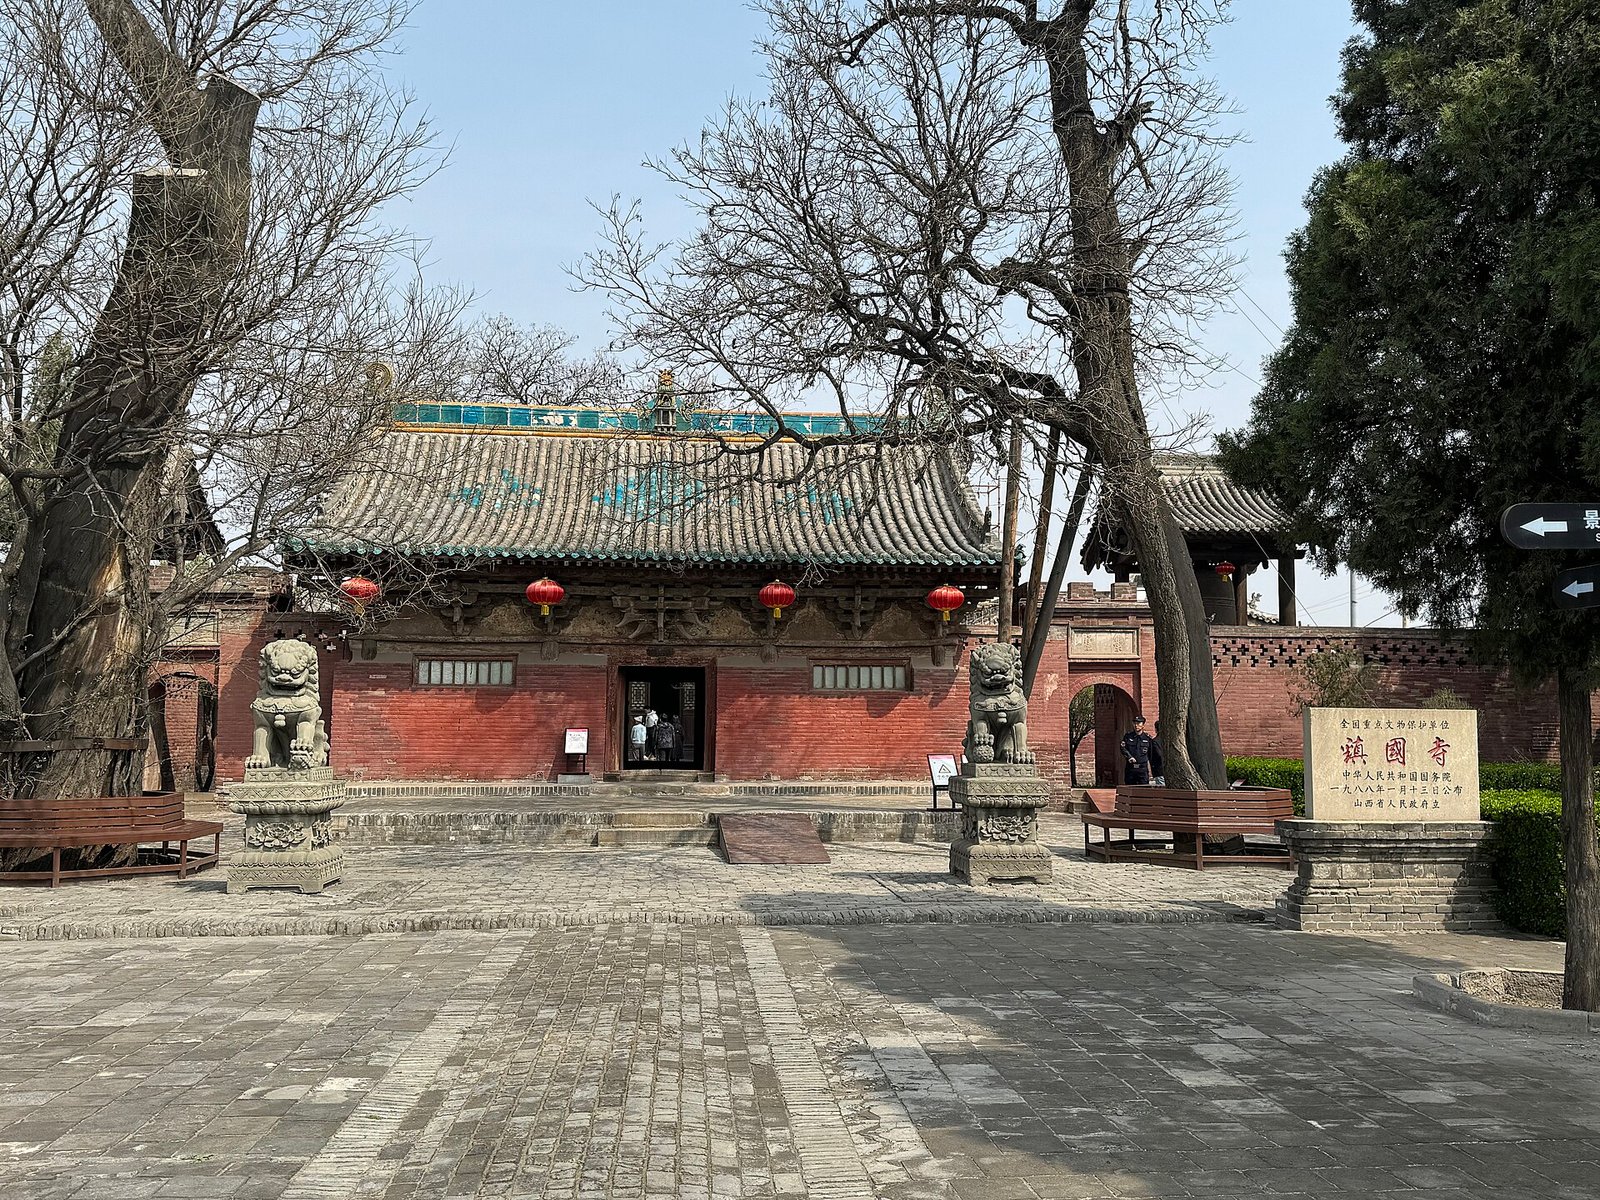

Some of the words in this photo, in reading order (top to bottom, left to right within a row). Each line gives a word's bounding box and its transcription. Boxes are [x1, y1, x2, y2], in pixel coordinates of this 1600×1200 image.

[1583, 509, 1600, 530] 景
[1339, 719, 1450, 730] 全国重点文物保护单位
[1342, 769, 1452, 782] 中华人民共和国国务院
[1330, 784, 1463, 796] 一九八八年一月十三日公布
[1354, 799, 1440, 809] 山西省人民政府立
